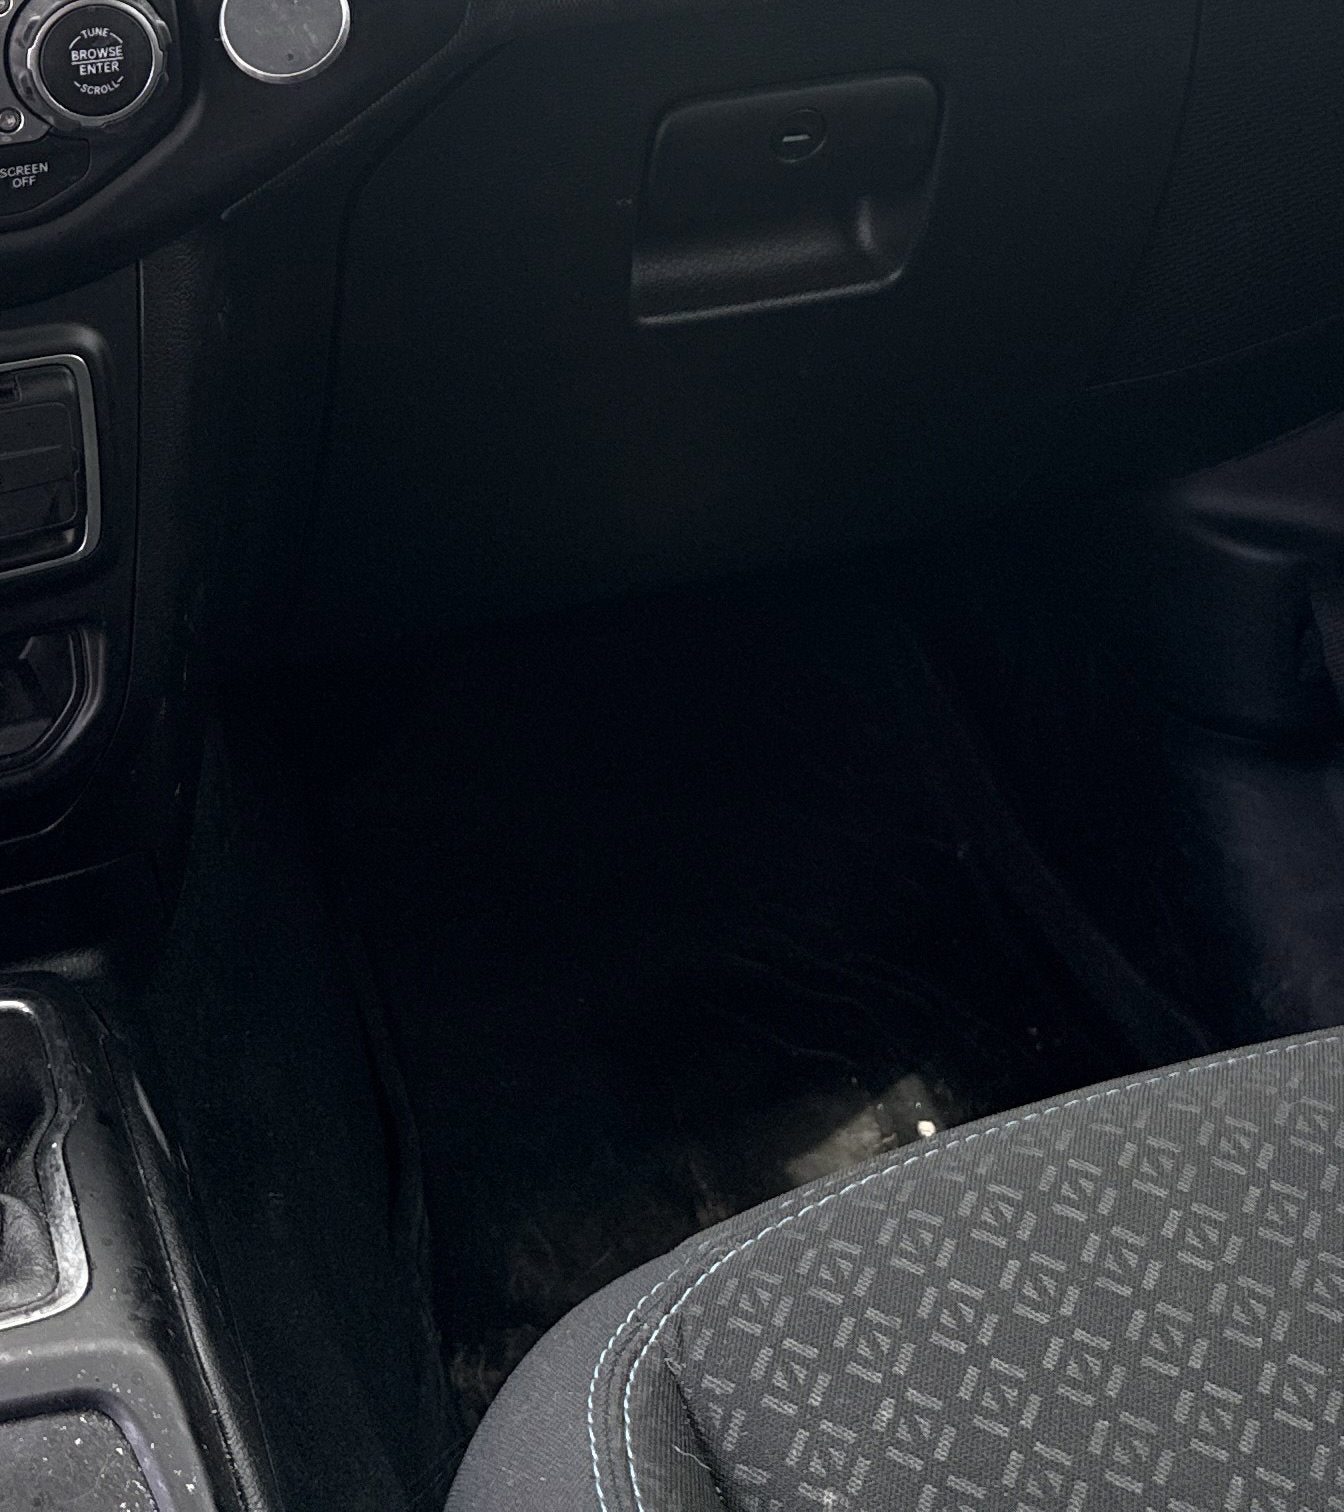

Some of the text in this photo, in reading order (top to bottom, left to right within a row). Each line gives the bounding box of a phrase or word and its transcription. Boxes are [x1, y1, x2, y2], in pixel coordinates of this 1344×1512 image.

[80, 27, 110, 39] TUNE
[70, 45, 124, 61] BROWSE
[79, 61, 120, 76] ENTER
[80, 80, 120, 95] SCROLL
[0, 162, 49, 179] SCREEN
[12, 175, 37, 188] OFF
